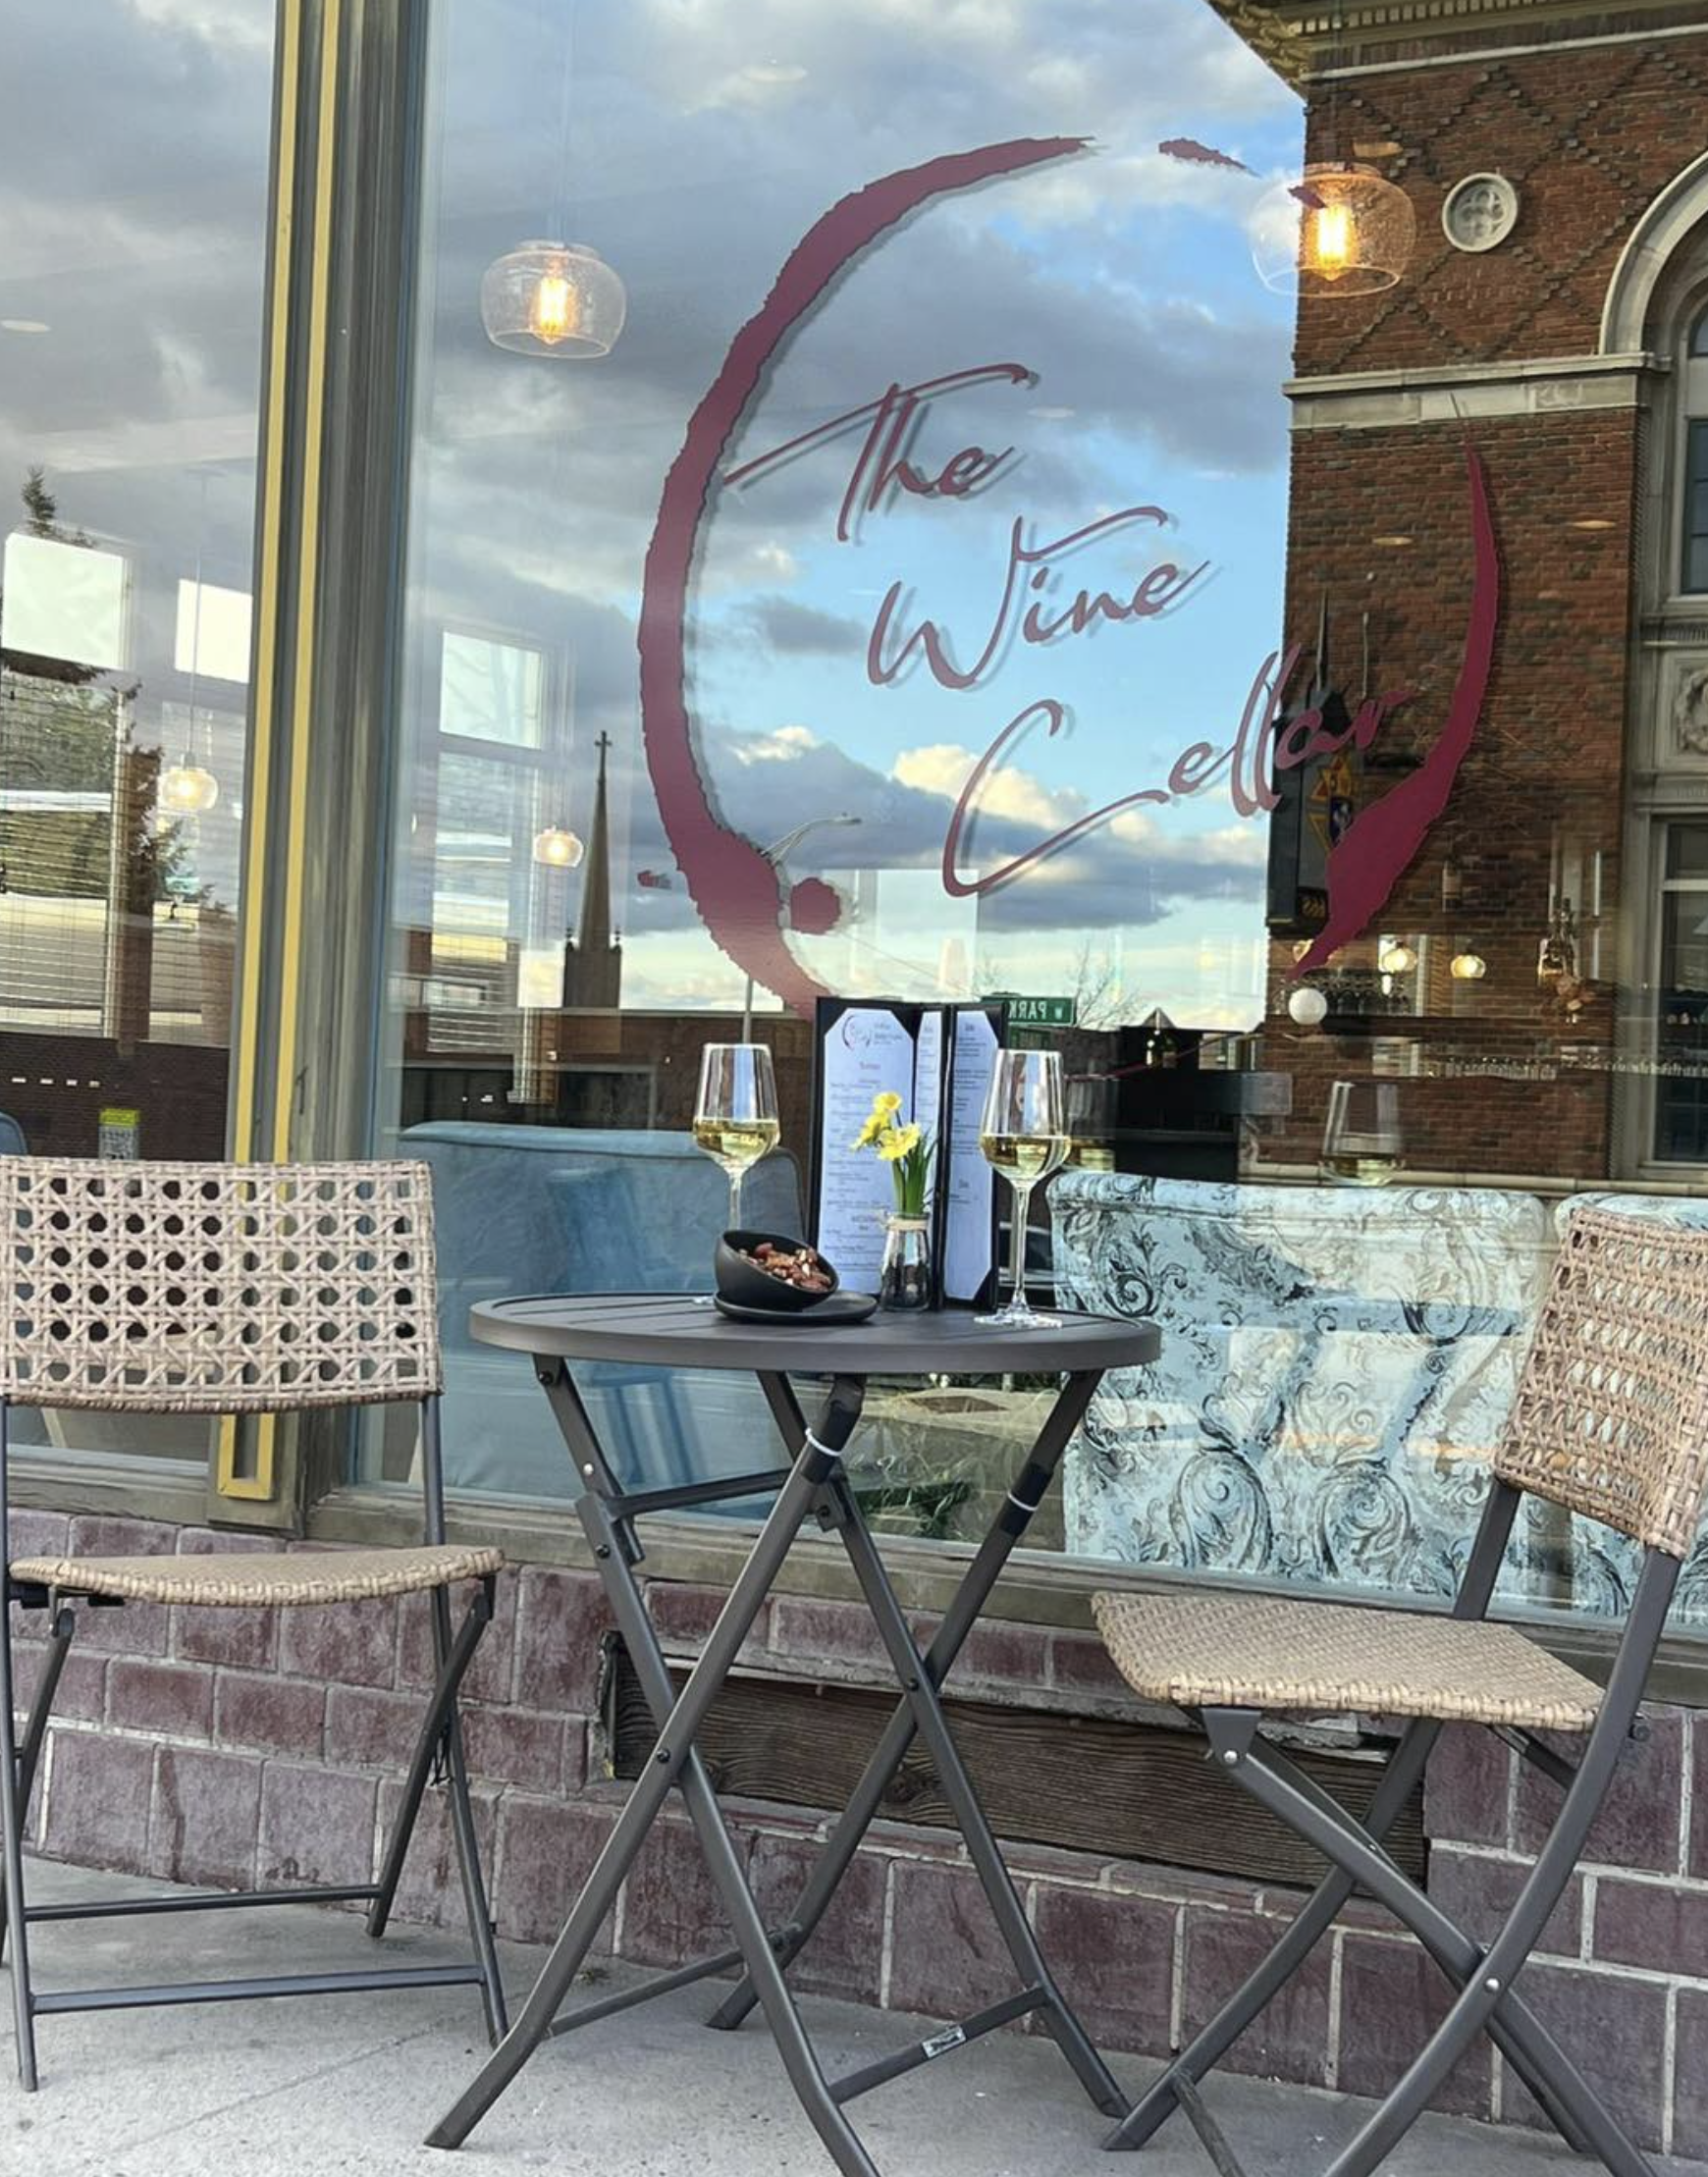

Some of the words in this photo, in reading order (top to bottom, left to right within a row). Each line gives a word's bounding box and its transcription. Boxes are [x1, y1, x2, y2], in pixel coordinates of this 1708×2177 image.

[722, 363, 1031, 542] The
[867, 505, 1210, 689] Wine
[941, 643, 1414, 897] Cellar
